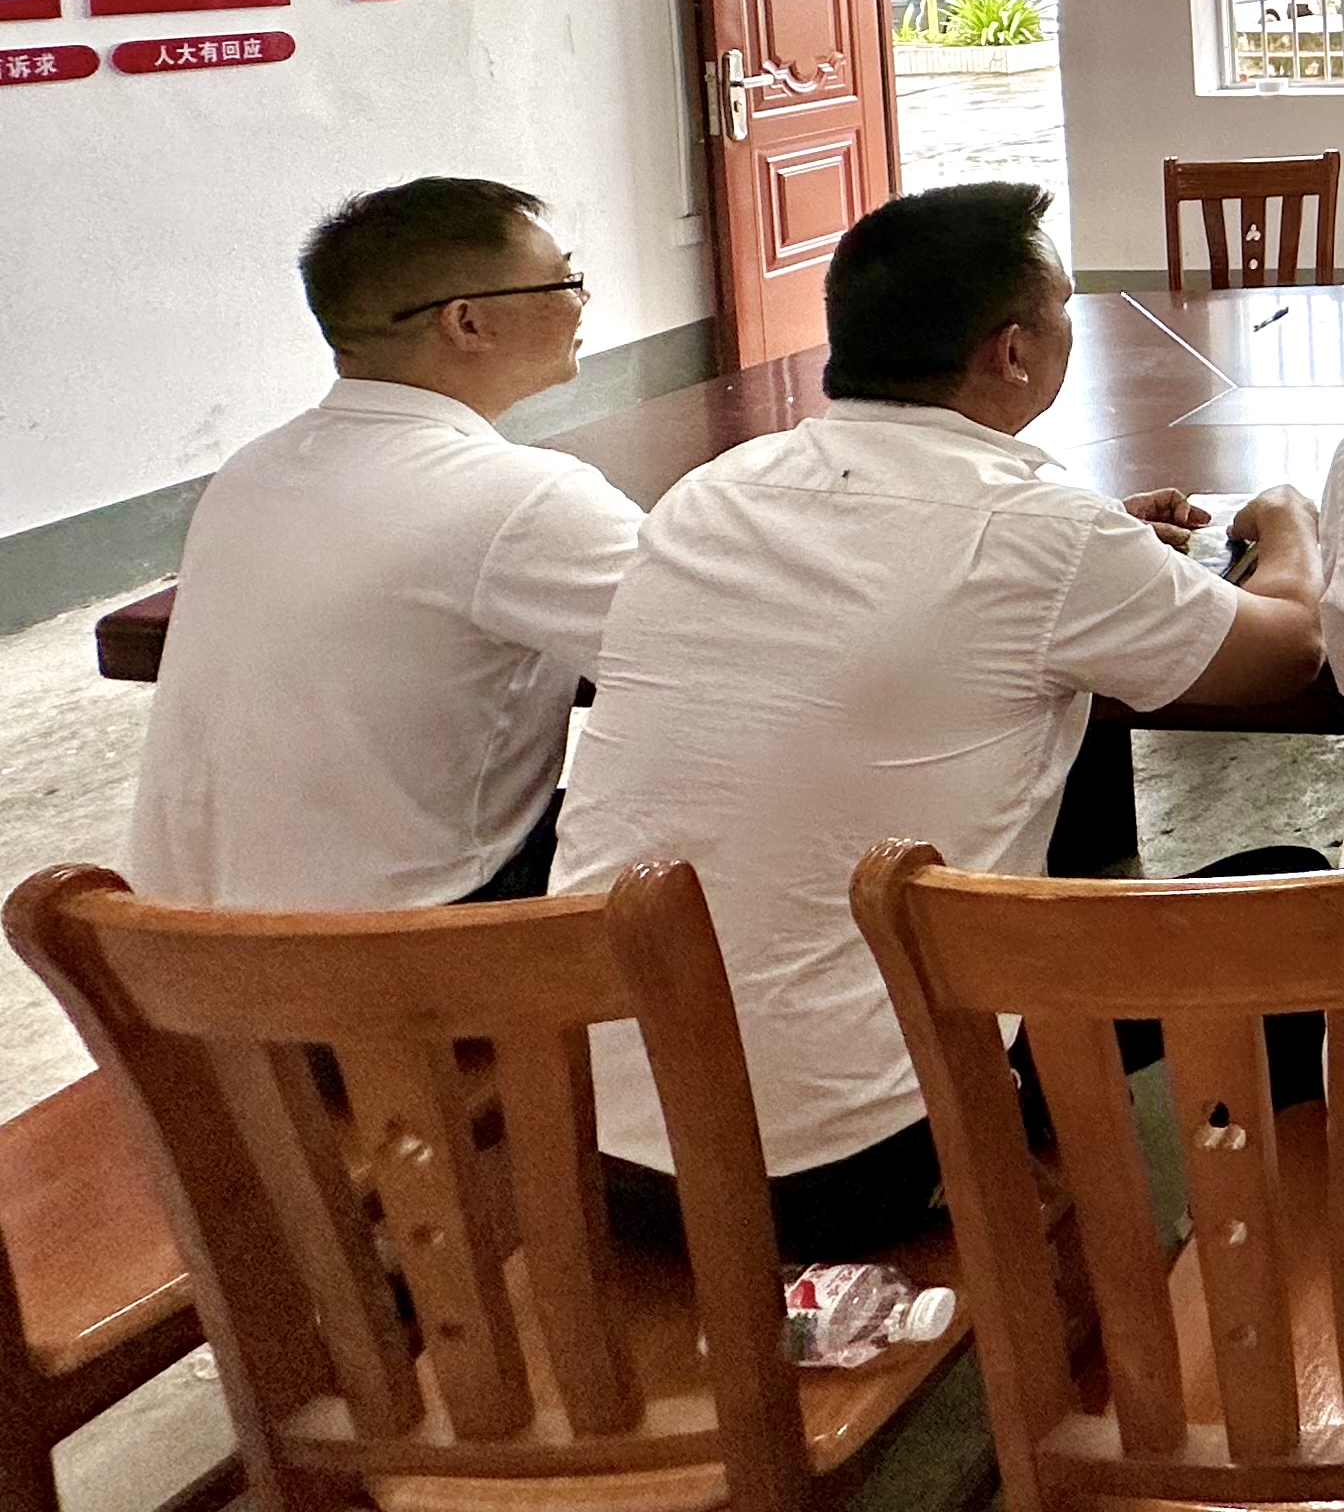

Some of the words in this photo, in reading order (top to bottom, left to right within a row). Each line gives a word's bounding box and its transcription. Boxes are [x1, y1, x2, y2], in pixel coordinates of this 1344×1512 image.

[153, 38, 263, 66] 人大有回应
[0, 53, 58, 80] 诉求
